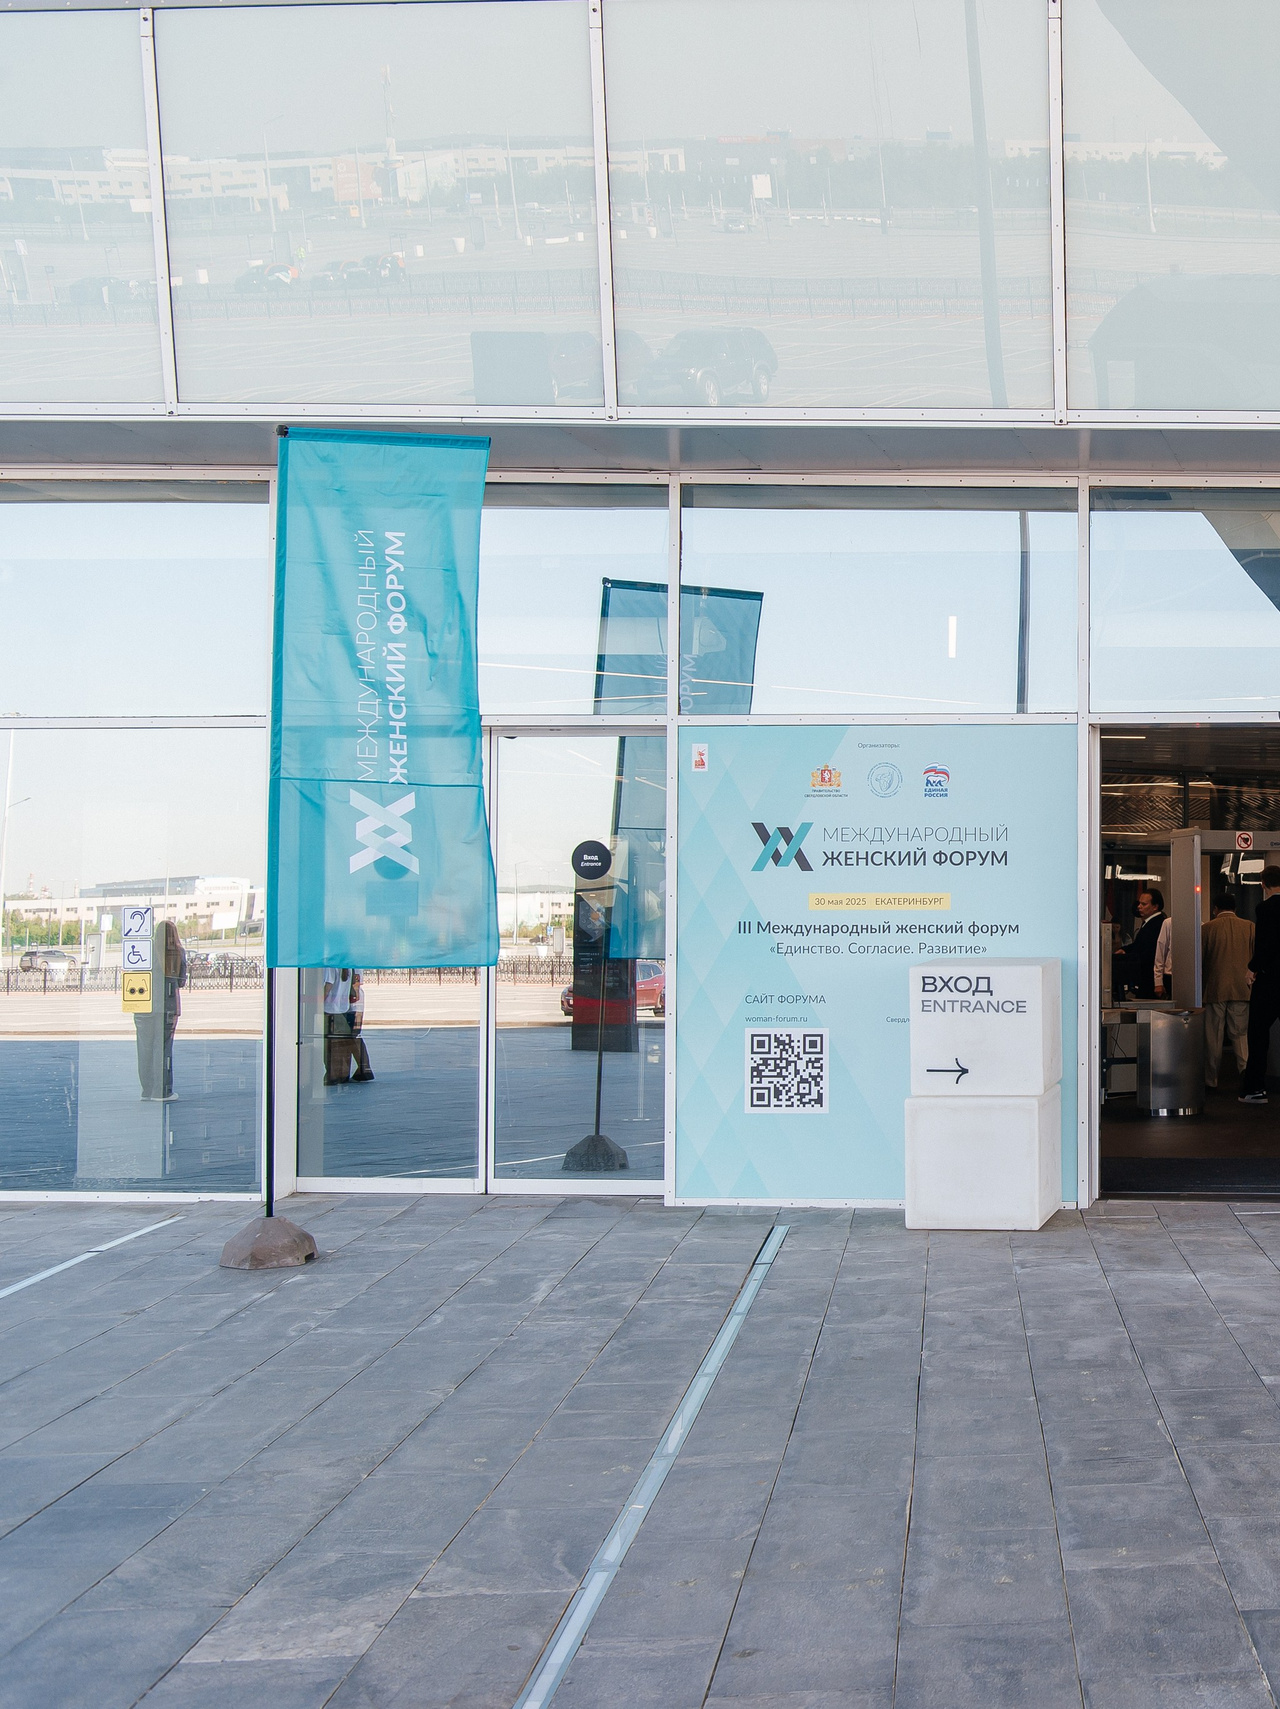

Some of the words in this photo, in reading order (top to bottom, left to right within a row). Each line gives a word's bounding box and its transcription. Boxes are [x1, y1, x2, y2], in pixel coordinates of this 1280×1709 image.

[385, 530, 407, 634] ФОРУМ
[354, 528, 381, 781] МЕЖДУНАРОДНЫЙ
[384, 642, 409, 785] ЖЕНСКИЙ
[822, 823, 1009, 845] МЕЖДУНАРОДНЫЙ
[822, 847, 927, 867] ЖЕНСКИЙ
[932, 849, 1009, 868] ФОРУМ
[814, 897, 827, 906] 30
[828, 898, 845, 906] мая
[845, 897, 867, 906] 2025
[875, 896, 944, 906] ЕКАТЕРИНБУРГ
[756, 919, 891, 938] Международный
[895, 919, 964, 935] женский
[967, 921, 1020, 939] форум
[769, 942, 844, 956] «Единство.
[848, 942, 914, 955] Согласие.
[918, 942, 987, 955] Развитие»
[921, 976, 994, 996] ВХОД
[745, 993, 774, 1005] САЙТ
[777, 993, 826, 1005] ФОРУМА
[921, 999, 1028, 1014] ENTRANCE
[745, 1014, 808, 1024] woman-forum.ru
